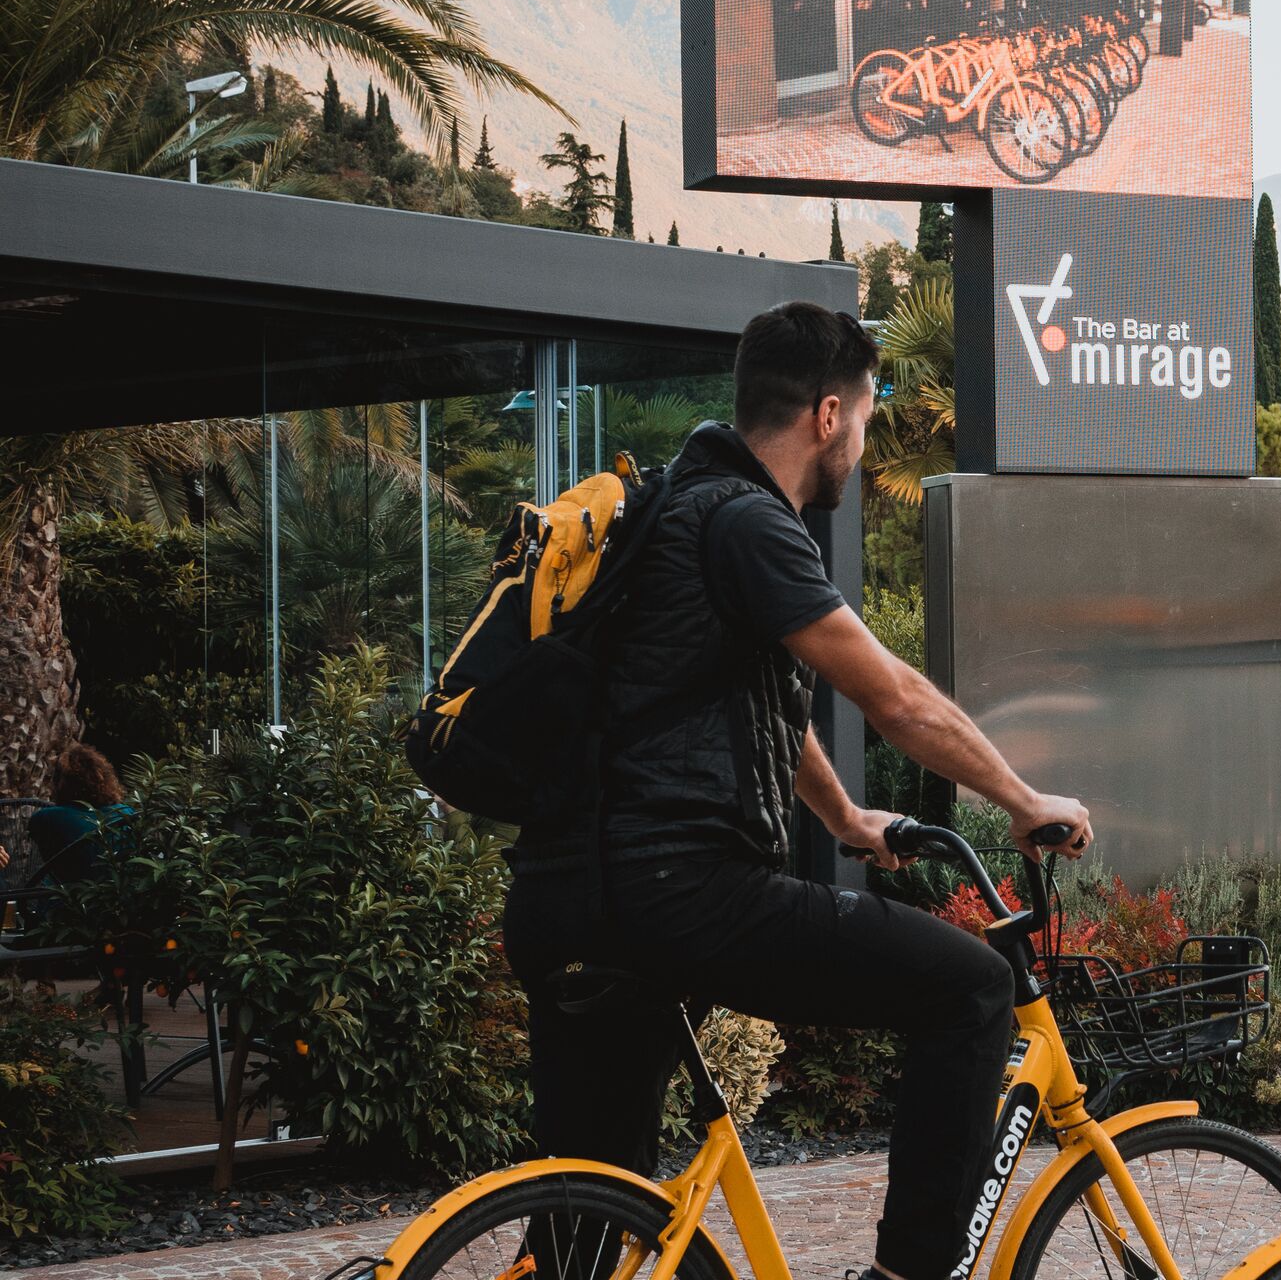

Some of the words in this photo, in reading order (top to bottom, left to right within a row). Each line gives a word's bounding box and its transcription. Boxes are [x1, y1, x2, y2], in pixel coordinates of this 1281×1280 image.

[1072, 316, 1116, 339] The
[1123, 318, 1162, 340] Bar
[1167, 320, 1190, 341] at
[1071, 341, 1231, 400] mirage
